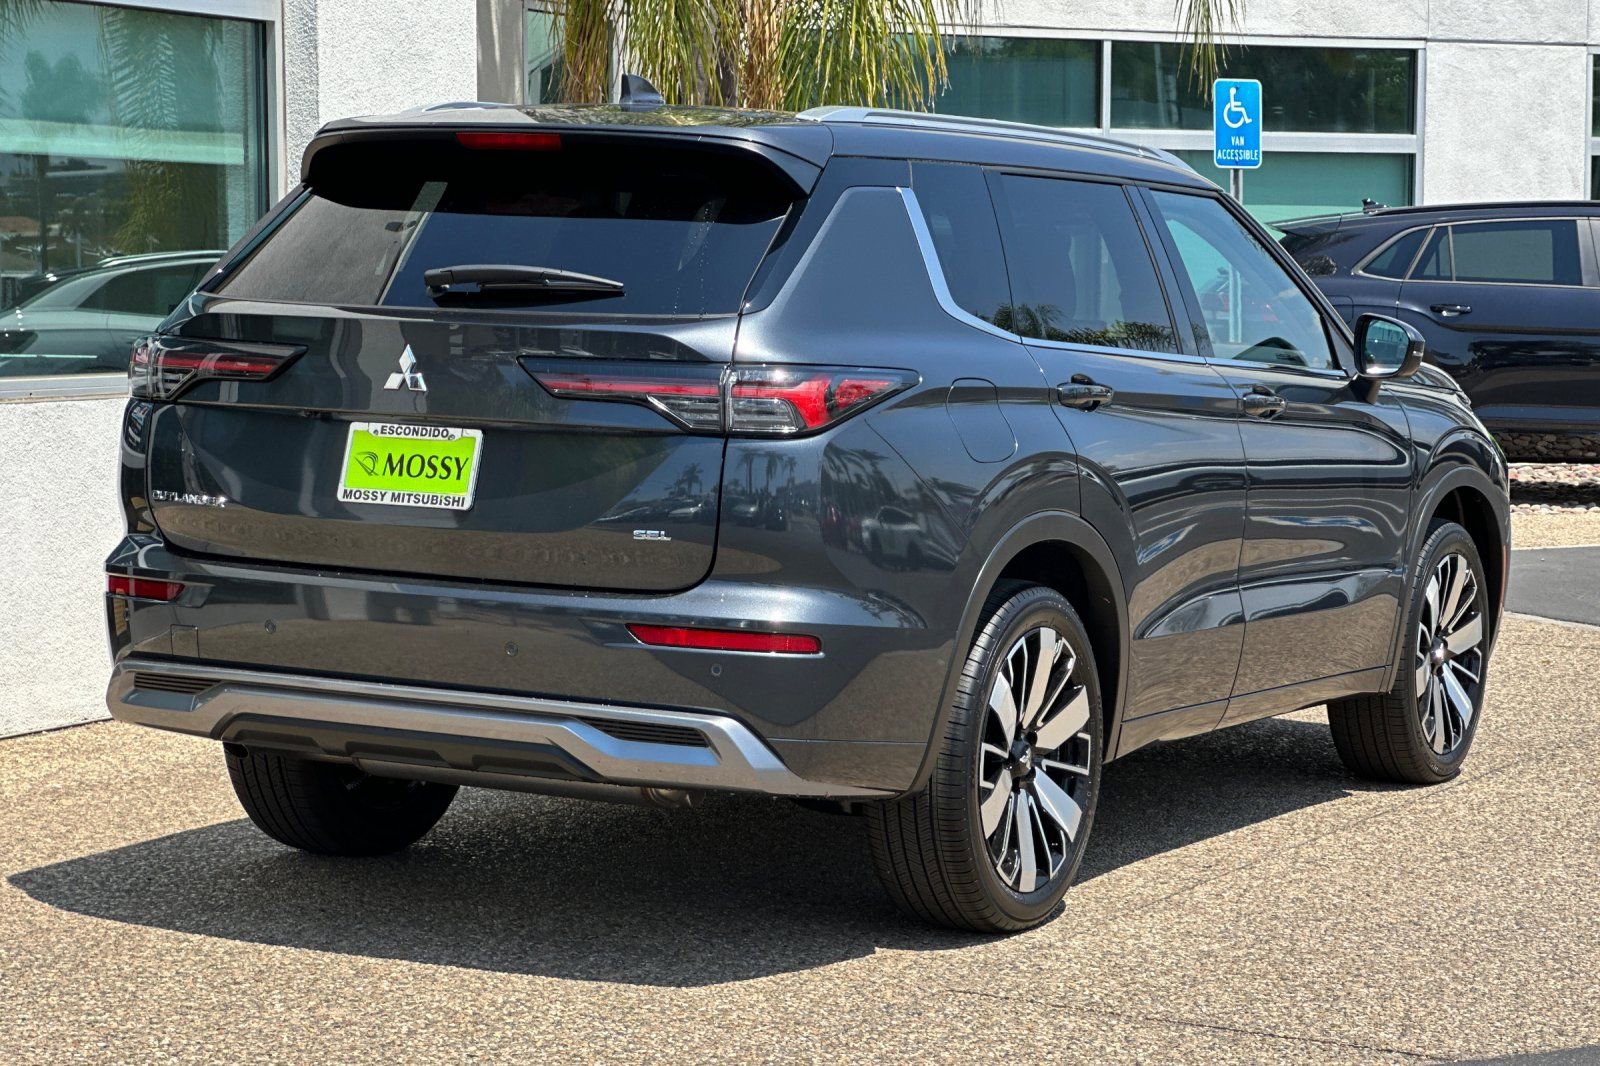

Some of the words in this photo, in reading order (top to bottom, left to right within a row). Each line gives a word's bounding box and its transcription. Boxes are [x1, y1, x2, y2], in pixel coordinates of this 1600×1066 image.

[1231, 135, 1245, 146] VAN
[1217, 149, 1259, 160] ACCESSIBLE
[380, 425, 449, 438] ESCONDIDO
[382, 452, 469, 480] MOSSY
[342, 488, 387, 502] MOSSY
